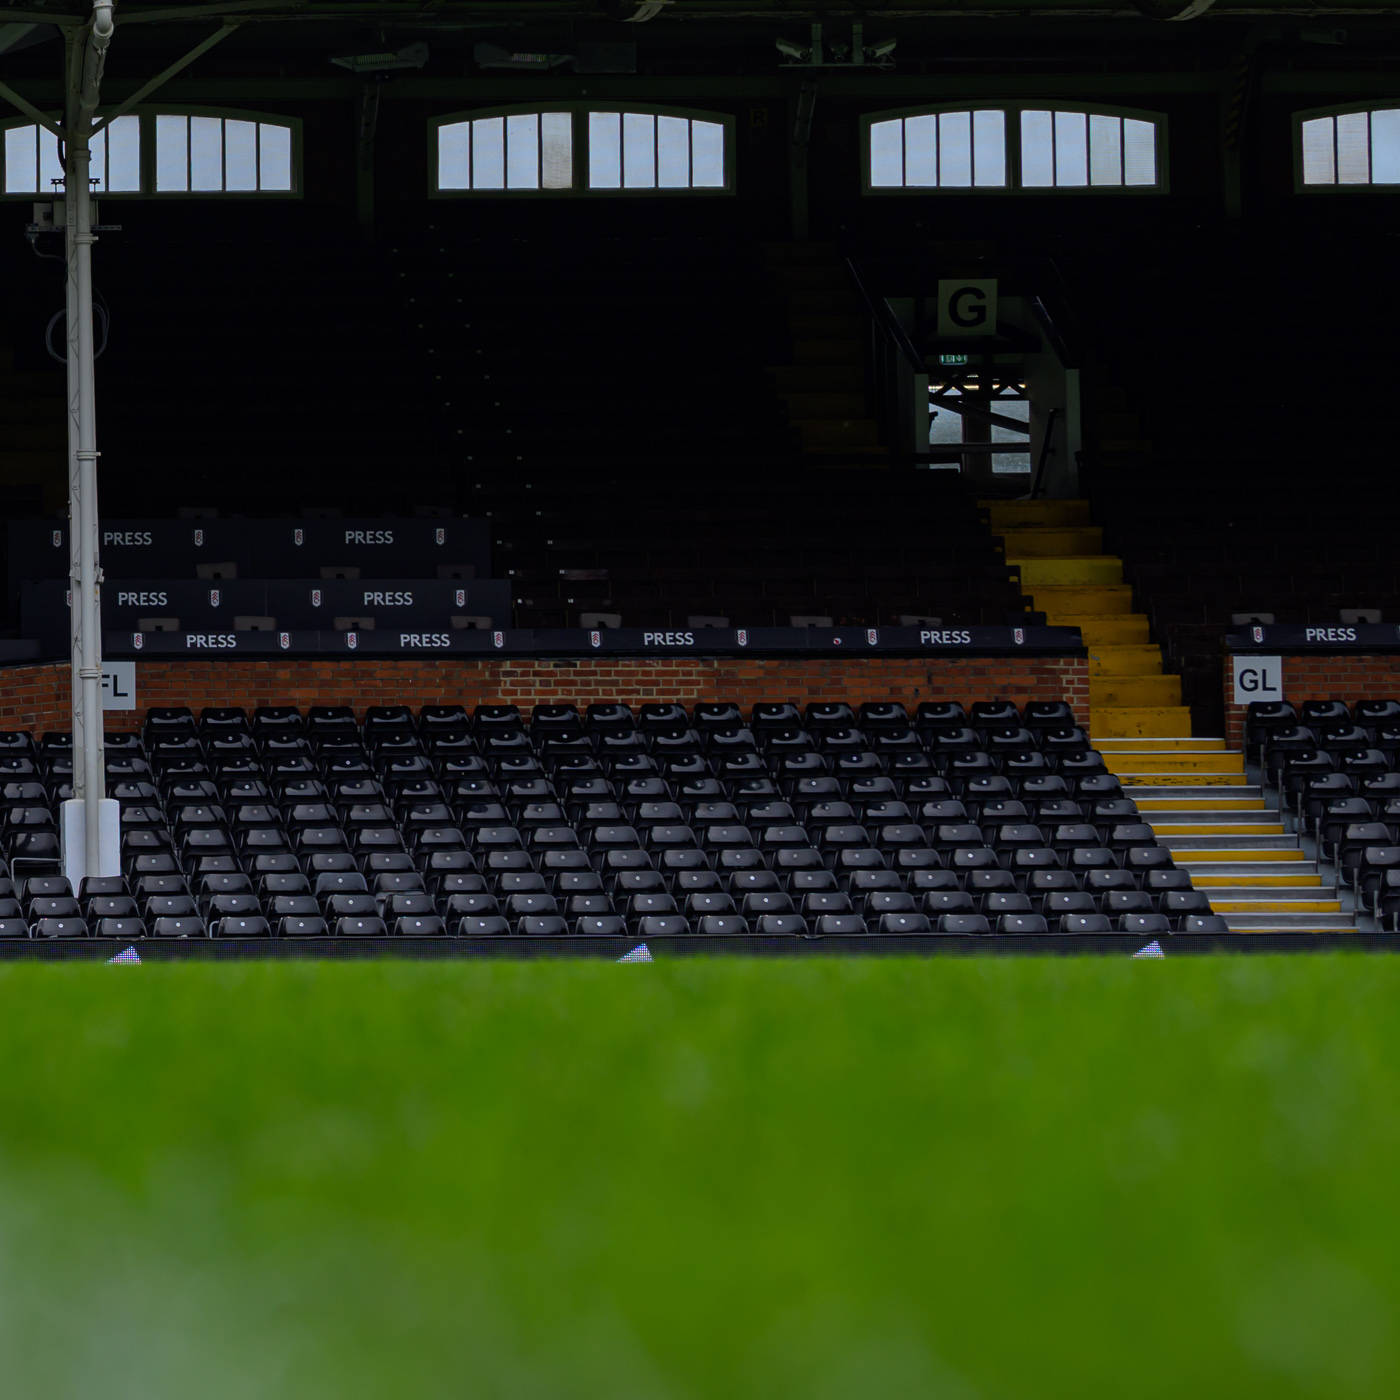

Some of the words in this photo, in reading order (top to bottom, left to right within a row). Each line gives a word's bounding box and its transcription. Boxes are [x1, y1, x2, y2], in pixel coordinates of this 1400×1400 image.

[948, 286, 988, 328] G
[103, 531, 153, 546] PRESS
[344, 530, 395, 545] PRESS
[117, 591, 168, 606] PRESS
[363, 591, 414, 606] PRESS
[186, 634, 237, 649] PRESS
[399, 633, 451, 648] PRESS
[643, 632, 695, 646] PRESS
[920, 630, 971, 645] PRESS
[1305, 627, 1357, 642] PRESS
[1239, 669, 1277, 692] GL
